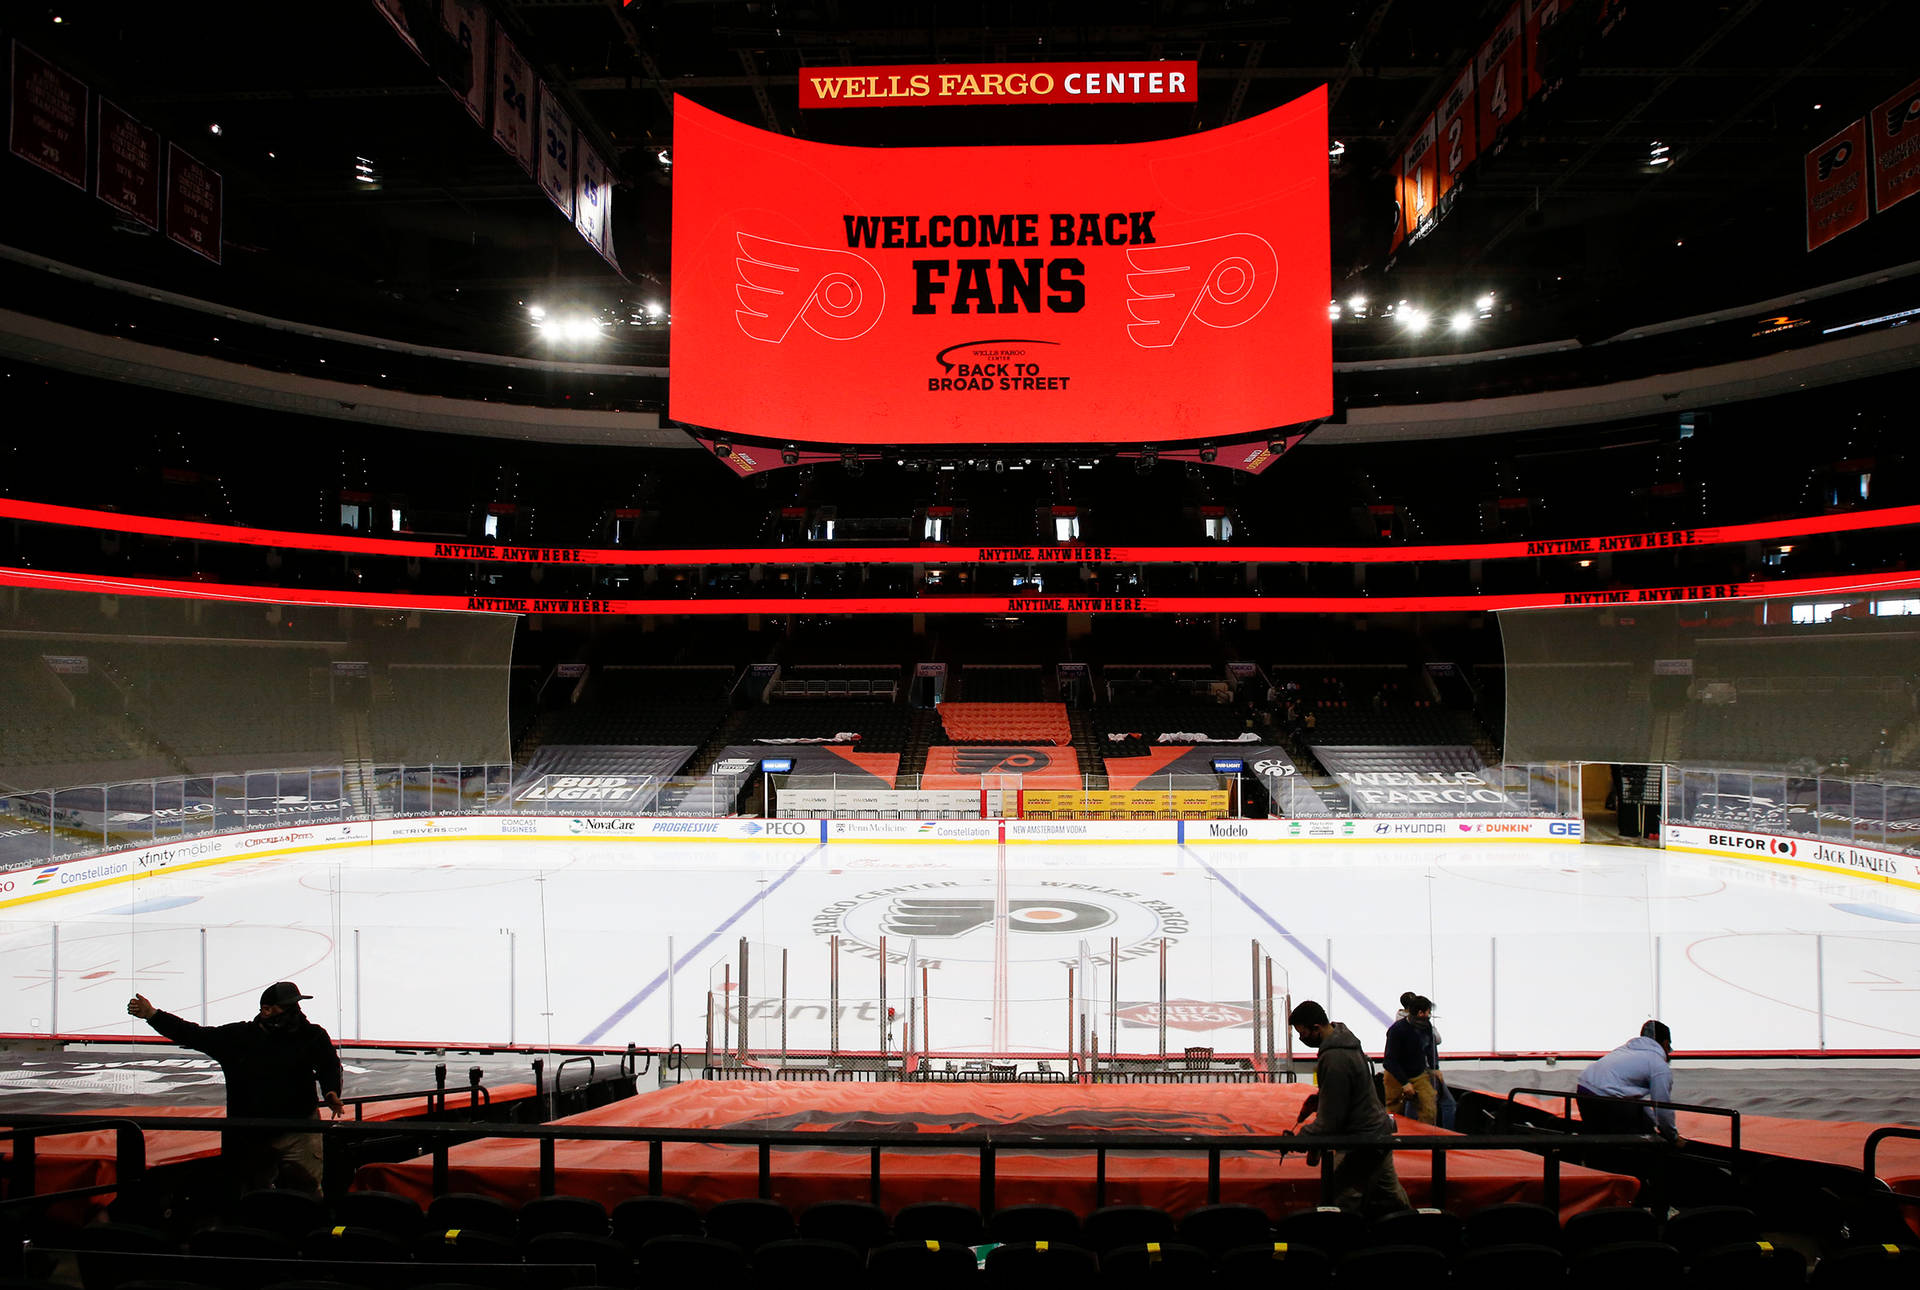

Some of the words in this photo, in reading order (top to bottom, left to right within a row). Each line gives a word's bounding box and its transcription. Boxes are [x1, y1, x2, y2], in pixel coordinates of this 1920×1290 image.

[810, 75, 930, 98] WELLS
[938, 73, 1054, 96] FARGO
[1064, 72, 1186, 94] CENTER
[1491, 63, 1509, 119] 4
[503, 75, 526, 123] 24
[547, 128, 567, 170] 32
[1448, 117, 1462, 173] 2
[584, 173, 599, 207] 15
[1415, 166, 1425, 212] 1
[843, 214, 1039, 249] WELCOME
[1050, 211, 1156, 246] BACK
[912, 258, 1086, 315] FANS
[958, 363, 1008, 377] BACK
[1014, 363, 1040, 377] TO
[928, 378, 993, 391] BROAD
[999, 377, 1070, 390] STREET
[1599, 531, 1703, 551] ANYWHERE.
[434, 544, 498, 560] ANYTIME.
[501, 548, 586, 562] ANYWHERE.
[978, 549, 1034, 560] ANYTIME.
[1038, 549, 1117, 560] ANYWHERE.
[533, 600, 615, 613] ANYWHERE.
[1008, 599, 1064, 611] ANYTIME.
[1067, 599, 1146, 611] ANYWHERE.
[553, 777, 628, 788] BUD
[1335, 771, 1487, 786] WELLS
[526, 787, 634, 799] LIGHT
[1357, 789, 1509, 804] FARGO
[153, 803, 213, 818] PECO
[392, 827, 467, 835] BETRIVERS.COM
[585, 819, 635, 830] NovaCare
[652, 822, 719, 832] PROGRESSIVE
[765, 822, 805, 835] PECO
[848, 824, 867, 832] Penn
[868, 824, 907, 832] Medicine
[937, 826, 990, 837] Constellation
[1013, 826, 1026, 834] NEW
[1026, 826, 1064, 834] AMSTERDAM
[1065, 825, 1087, 834] VODKA
[1209, 823, 1248, 837] Modelo
[1395, 824, 1446, 832] HYUNDAI
[1549, 823, 1581, 836] GE
[1709, 835, 1766, 850] BELFOR
[138, 849, 176, 868] xfinity
[177, 841, 222, 857] mobile
[1813, 845, 1845, 864] JACK
[60, 863, 128, 885] Constellation
[812, 899, 859, 936] FARGO
[855, 880, 959, 899] CENTER
[1040, 881, 1140, 900] WELLS
[1141, 899, 1189, 936] FARGO
